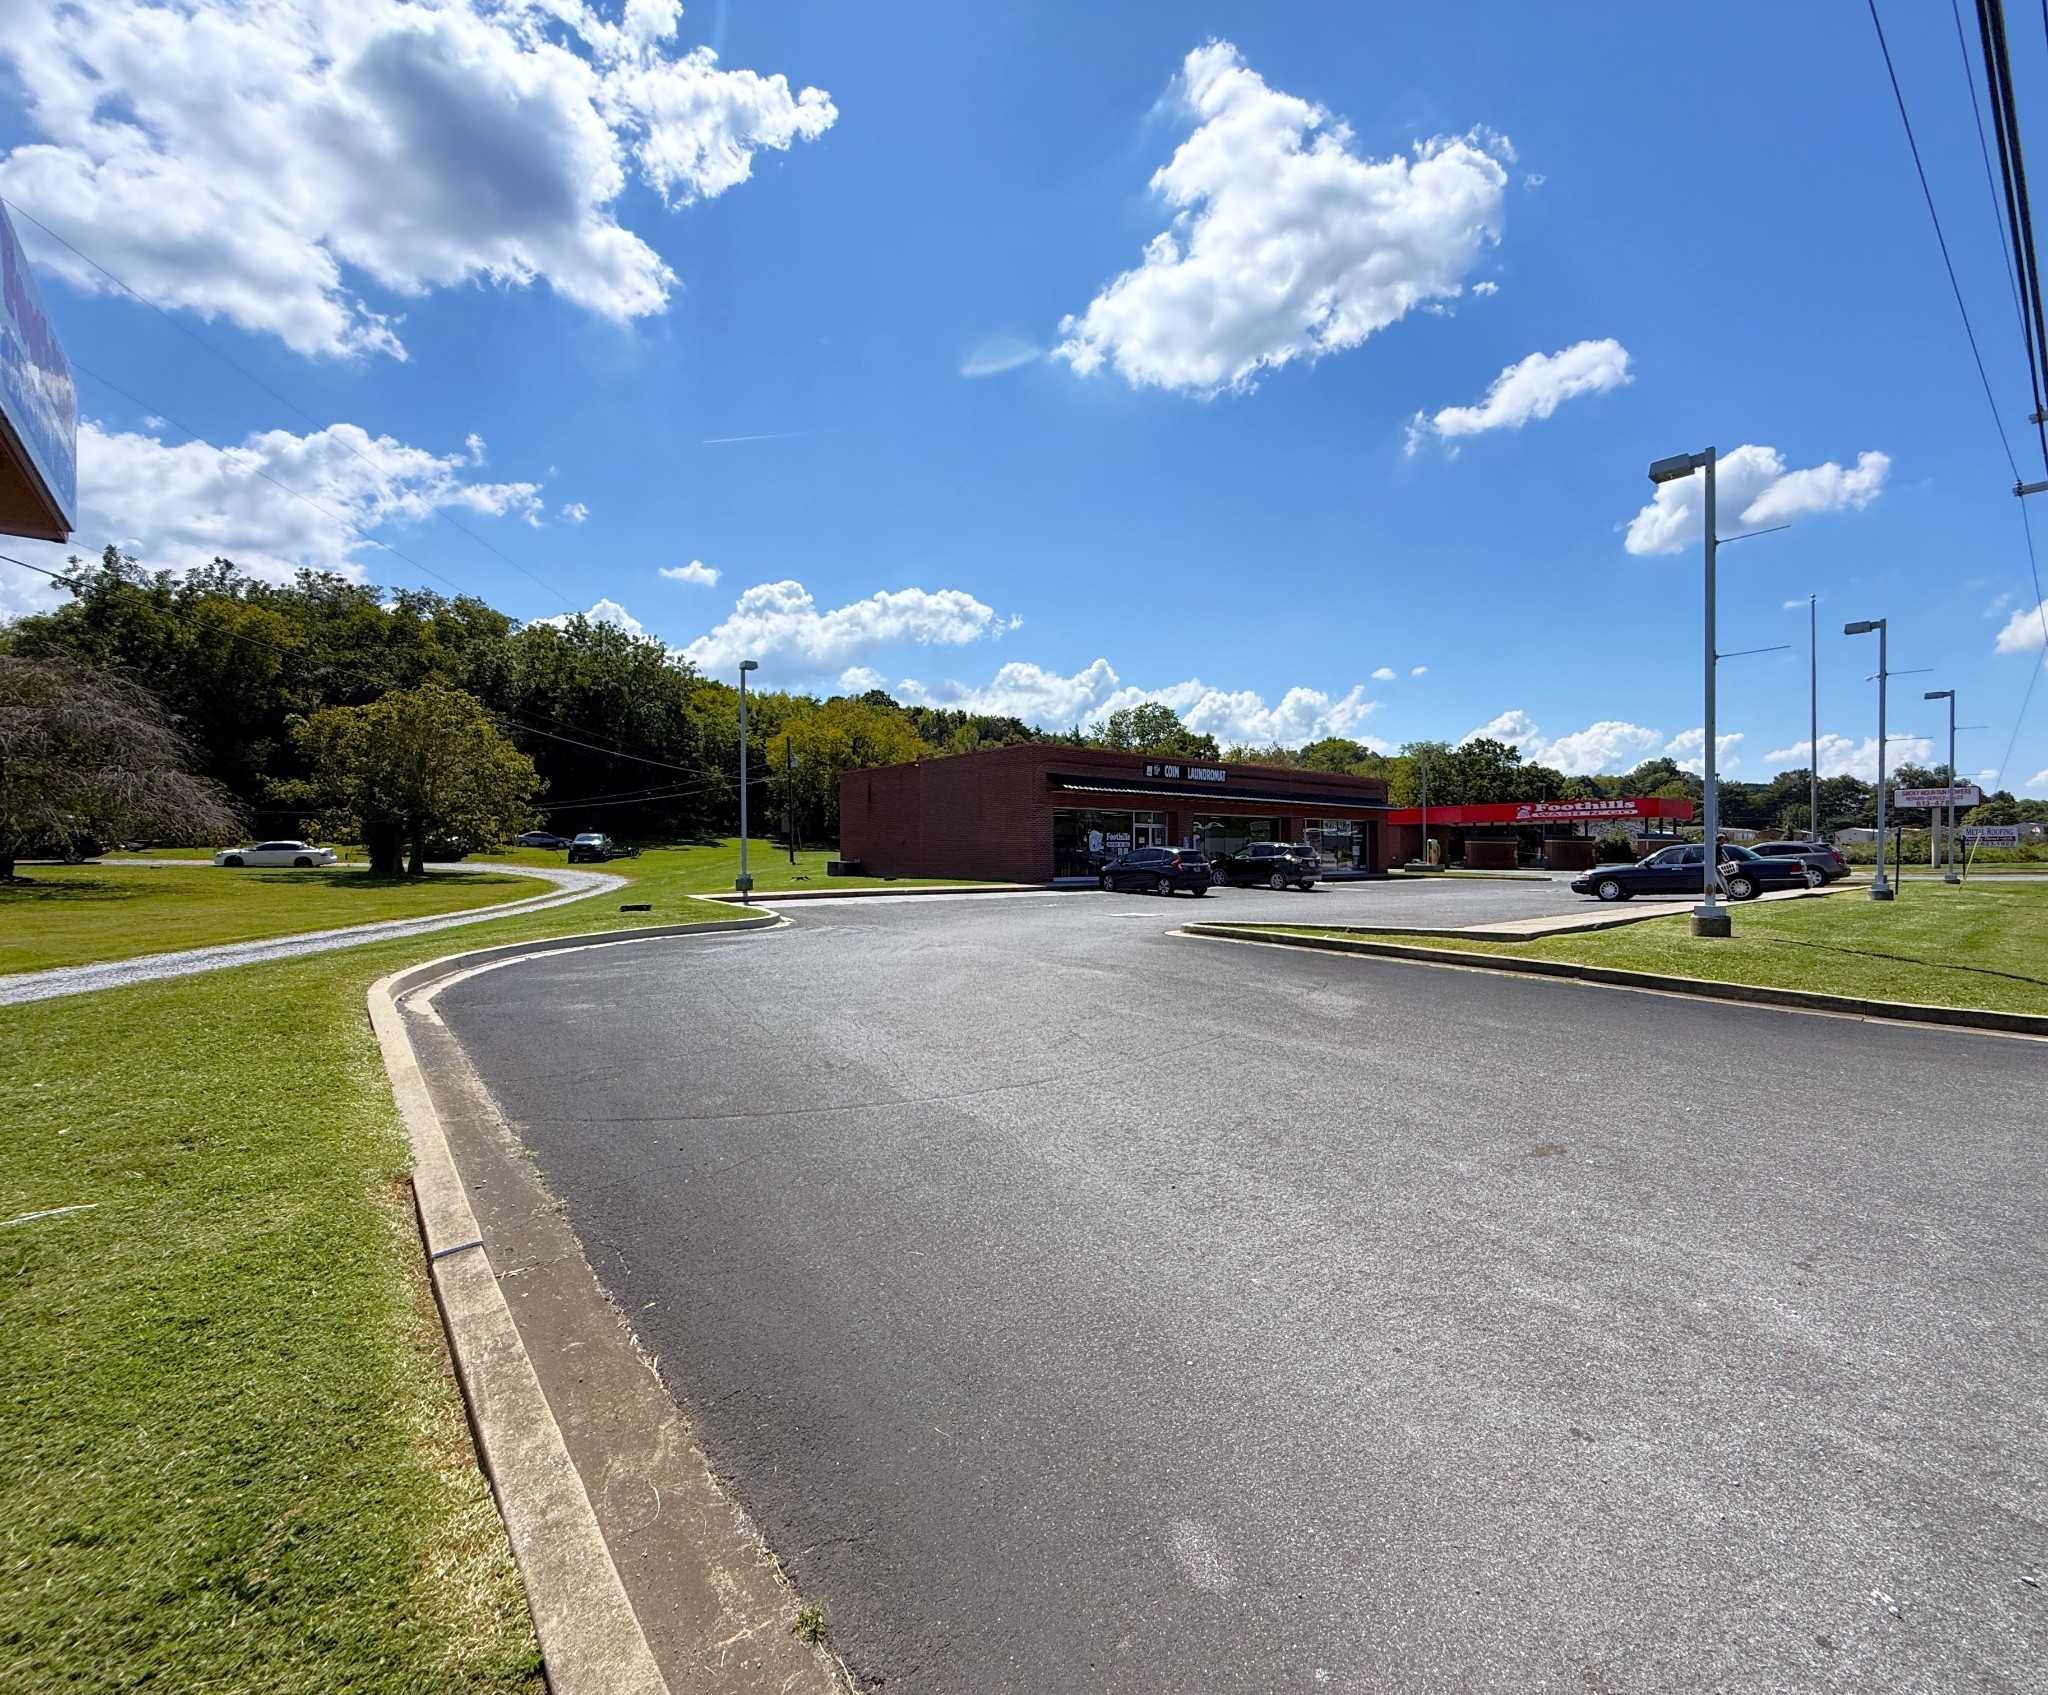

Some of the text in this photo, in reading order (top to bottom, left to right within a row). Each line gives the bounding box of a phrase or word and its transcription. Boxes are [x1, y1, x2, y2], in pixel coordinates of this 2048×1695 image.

[1164, 765, 1226, 782] COIN LAUNDROMAT
[1535, 801, 1635, 812] Foothills
[1106, 832, 1130, 840] Foothills
